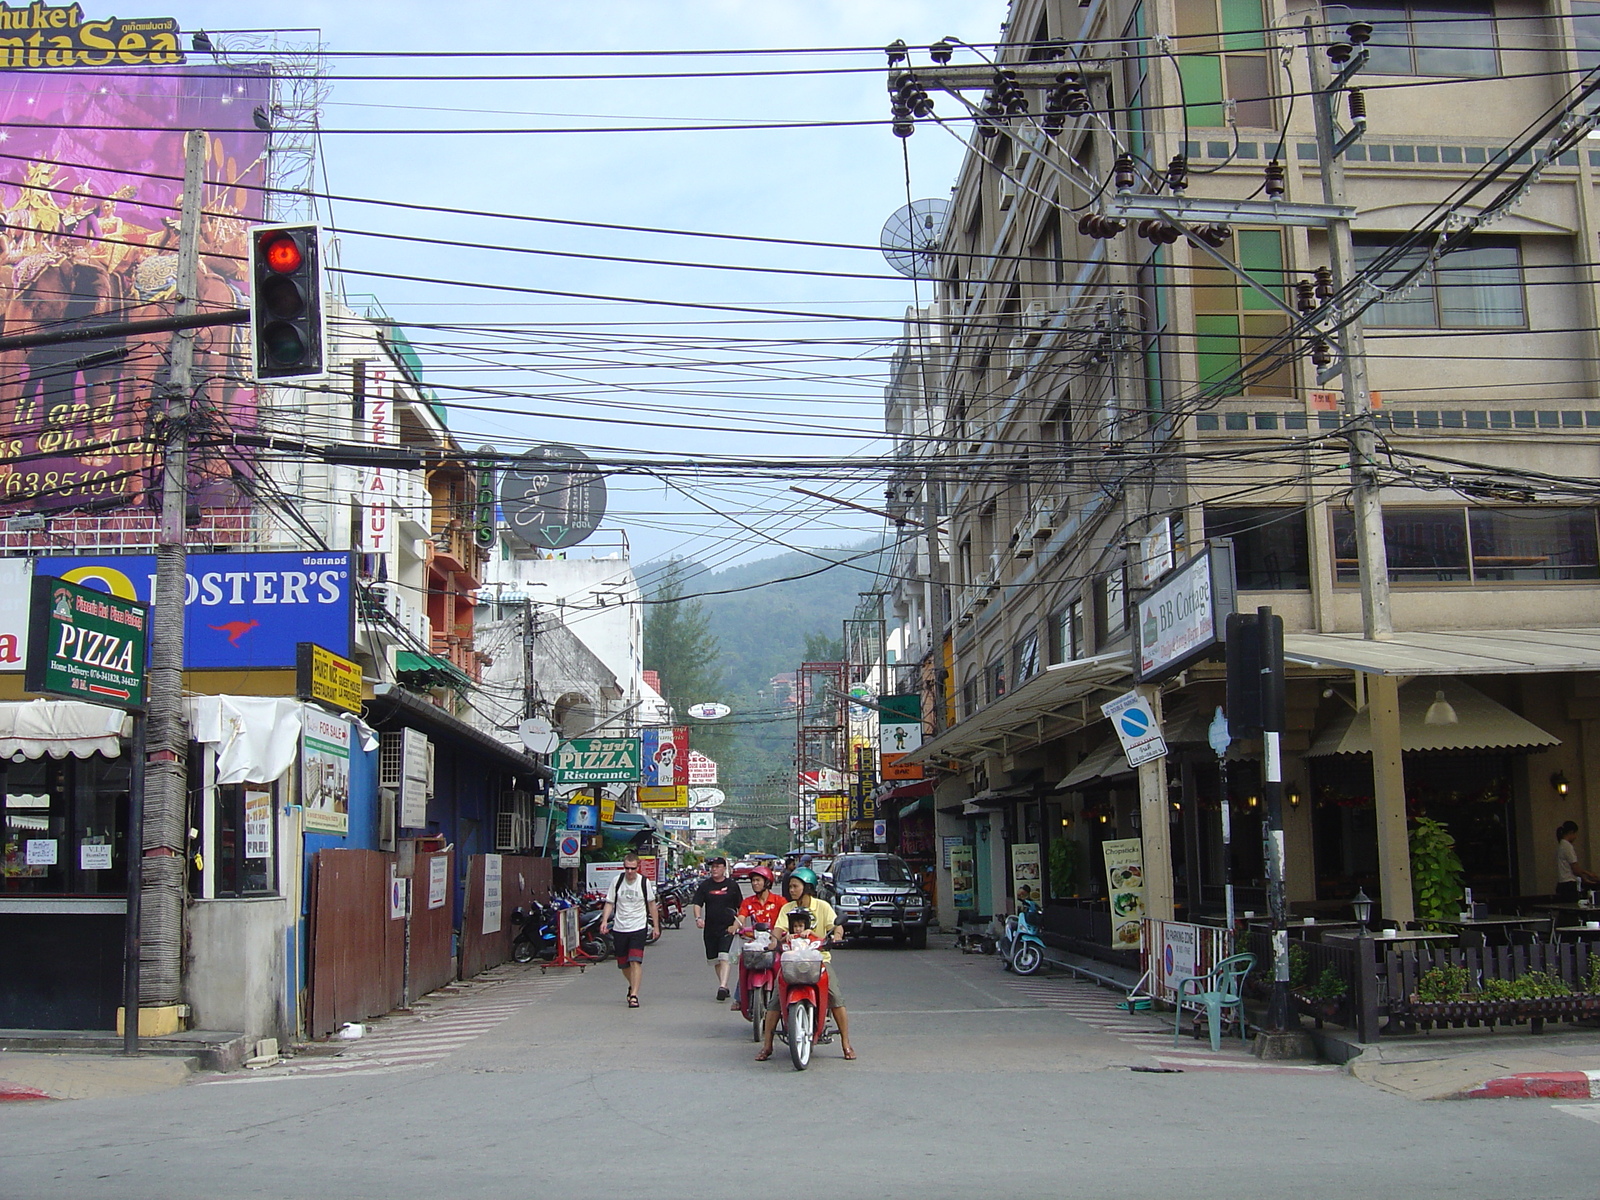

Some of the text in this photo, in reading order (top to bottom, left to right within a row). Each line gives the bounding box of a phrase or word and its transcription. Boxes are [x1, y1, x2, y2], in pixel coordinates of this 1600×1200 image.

[370, 502, 385, 549] HUT
[572, 521, 592, 529] POOL
[1159, 581, 1210, 633] BB Cottage
[55, 622, 134, 673] PIZZA
[50, 660, 67, 672] Home
[67, 663, 90, 679] Delivery:
[1104, 709, 1111, 717] NO
[1110, 704, 1124, 714] DOUBLE
[320, 721, 341, 740] FOR SALE
[558, 751, 635, 769] PIZZA
[563, 771, 630, 780] Ristorante
[247, 841, 269, 853] FREE
